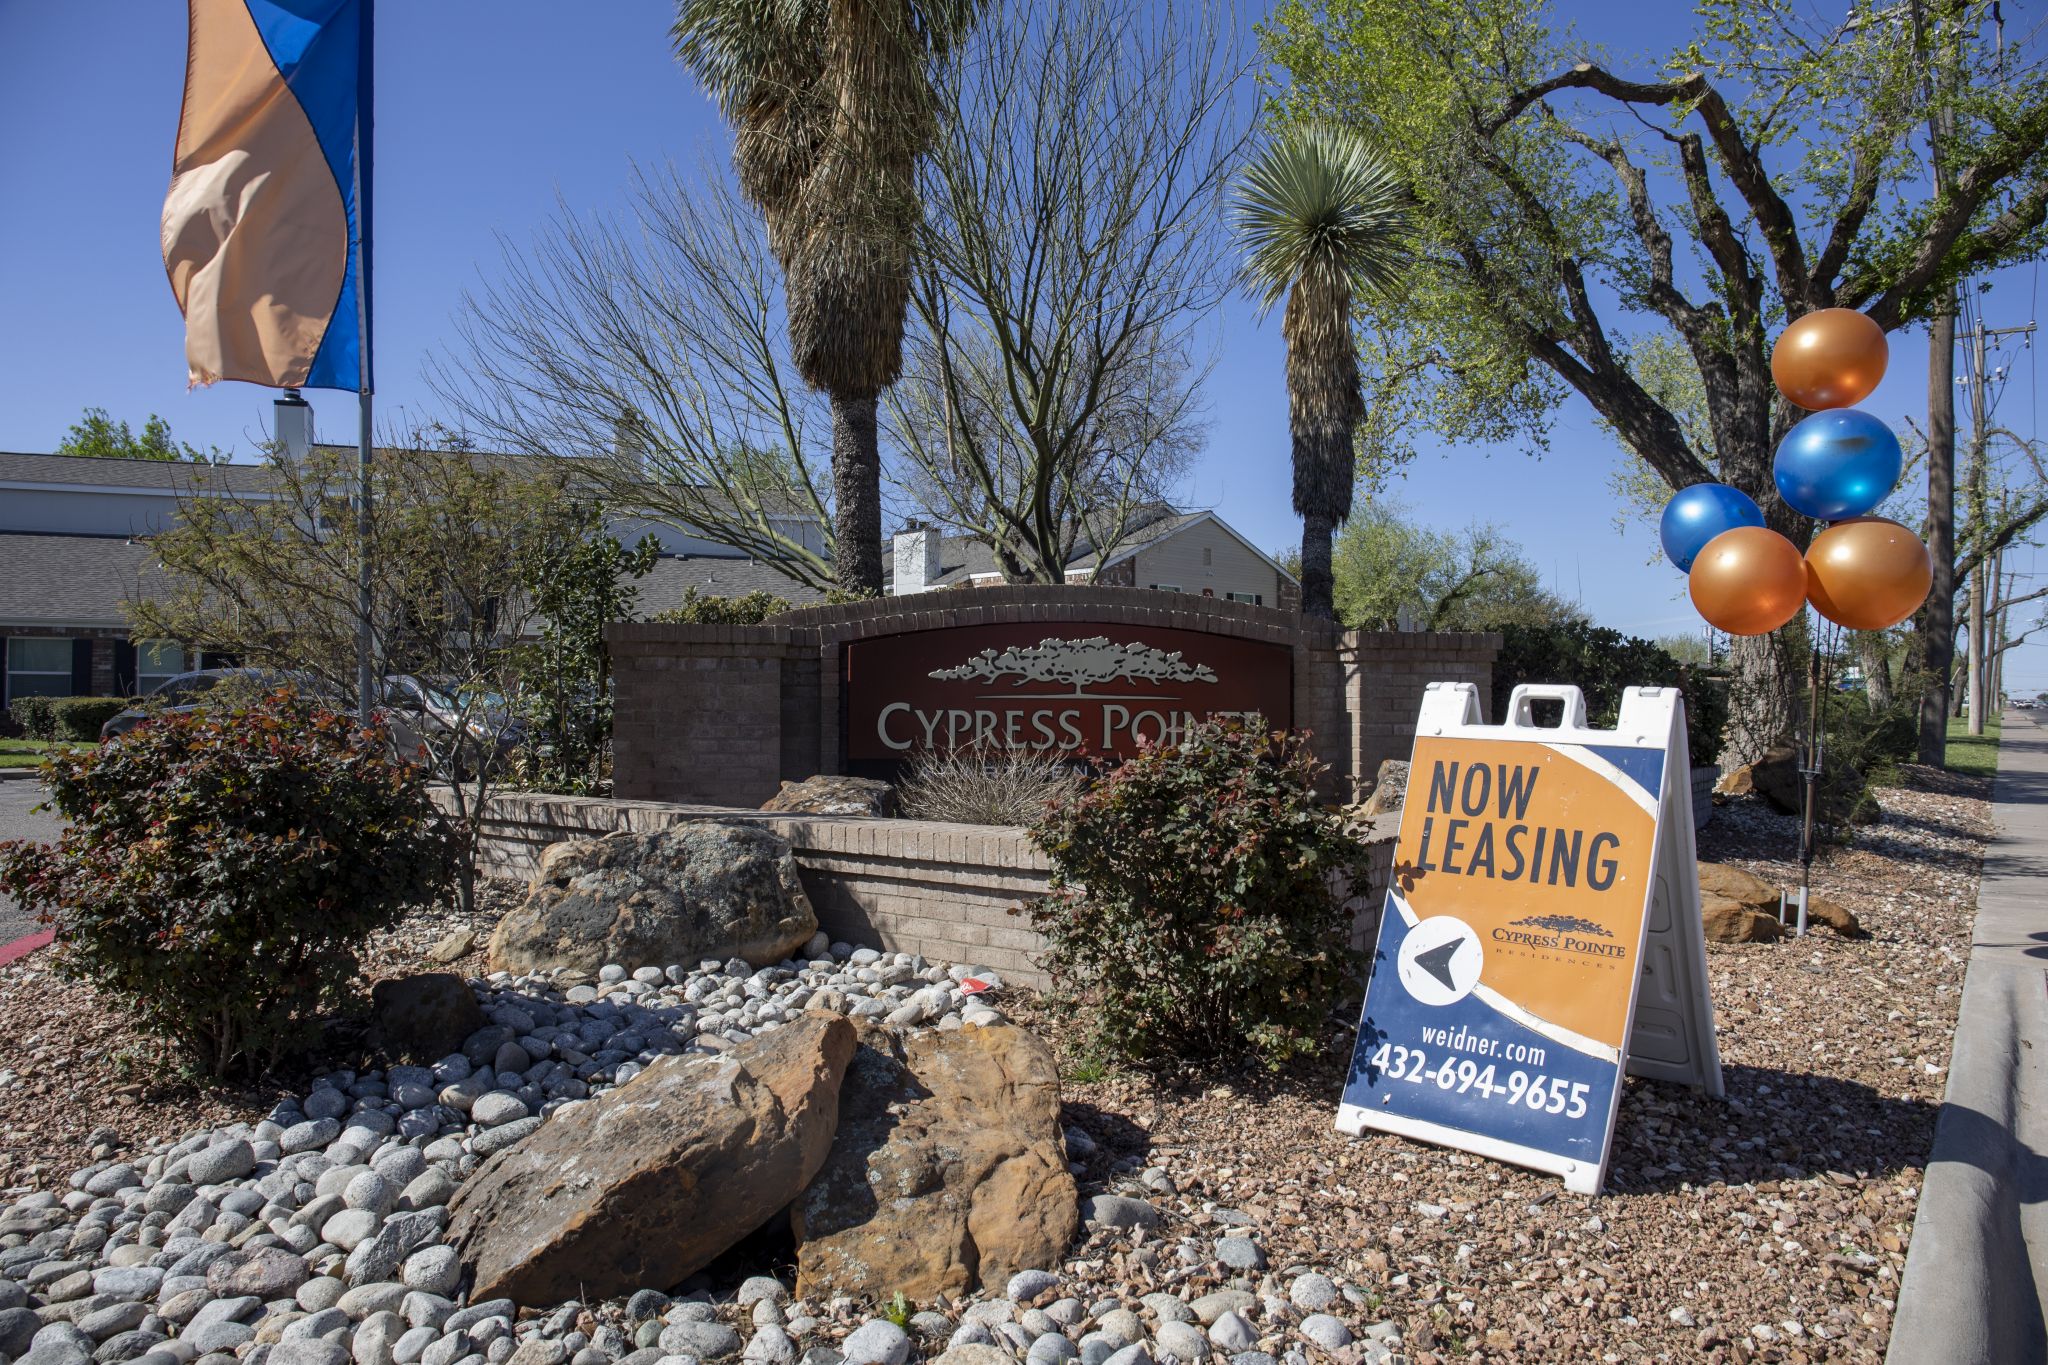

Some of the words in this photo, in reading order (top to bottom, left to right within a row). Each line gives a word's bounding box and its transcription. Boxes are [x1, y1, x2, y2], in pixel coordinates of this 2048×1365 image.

[877, 702, 1083, 750] CYPRESS
[1426, 760, 1540, 820] NOW
[1417, 816, 1620, 891] LEASING
[1492, 927, 1559, 950] CYPRESS
[1564, 937, 1626, 958] POINTE
[1496, 948, 1615, 970] RESIDENCES
[1422, 1025, 1546, 1066] weidner.com
[1371, 1043, 1590, 1118] 432-694-9655
